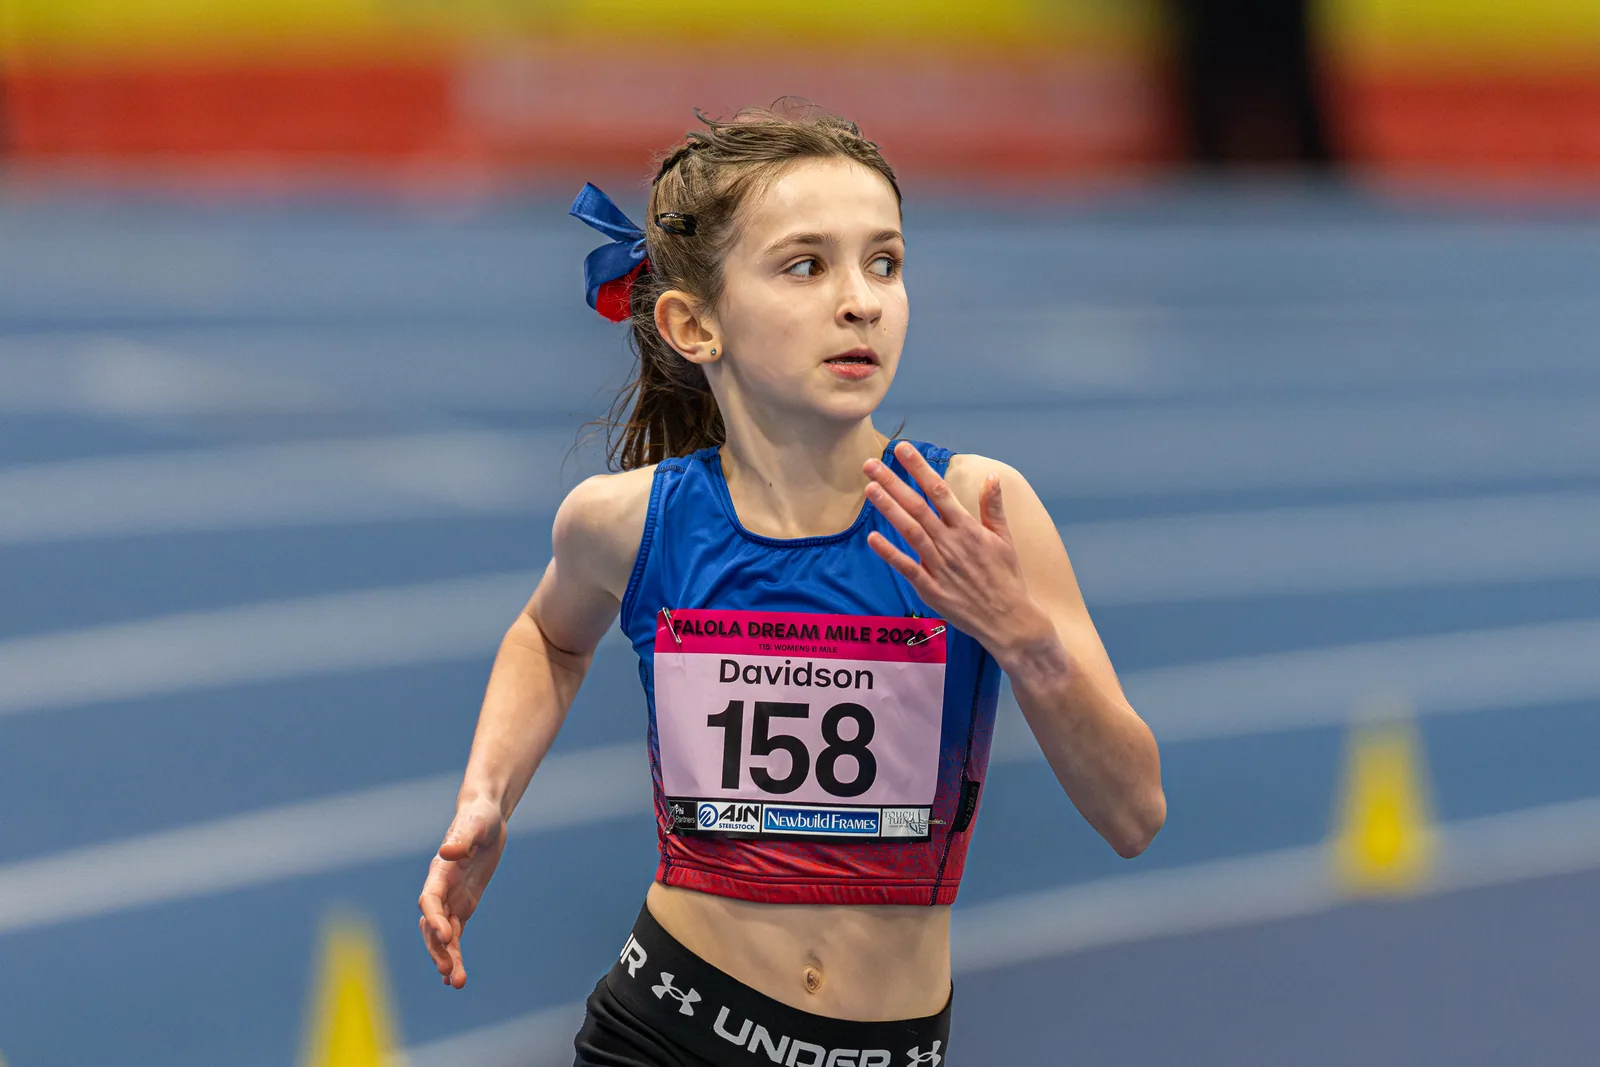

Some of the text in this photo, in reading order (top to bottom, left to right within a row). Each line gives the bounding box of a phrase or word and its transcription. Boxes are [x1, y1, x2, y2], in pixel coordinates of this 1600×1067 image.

[673, 619, 928, 646] FALOLA DREAM MILE 2026
[819, 646, 838, 654] MILE
[719, 659, 874, 690] Davidson
[707, 699, 877, 798] 158
[675, 814, 696, 824] Partners
[719, 804, 760, 823] AJN
[831, 814, 877, 830] FRAMES
[884, 810, 915, 818] TOUCH
[713, 1005, 891, 1067] UNDER
